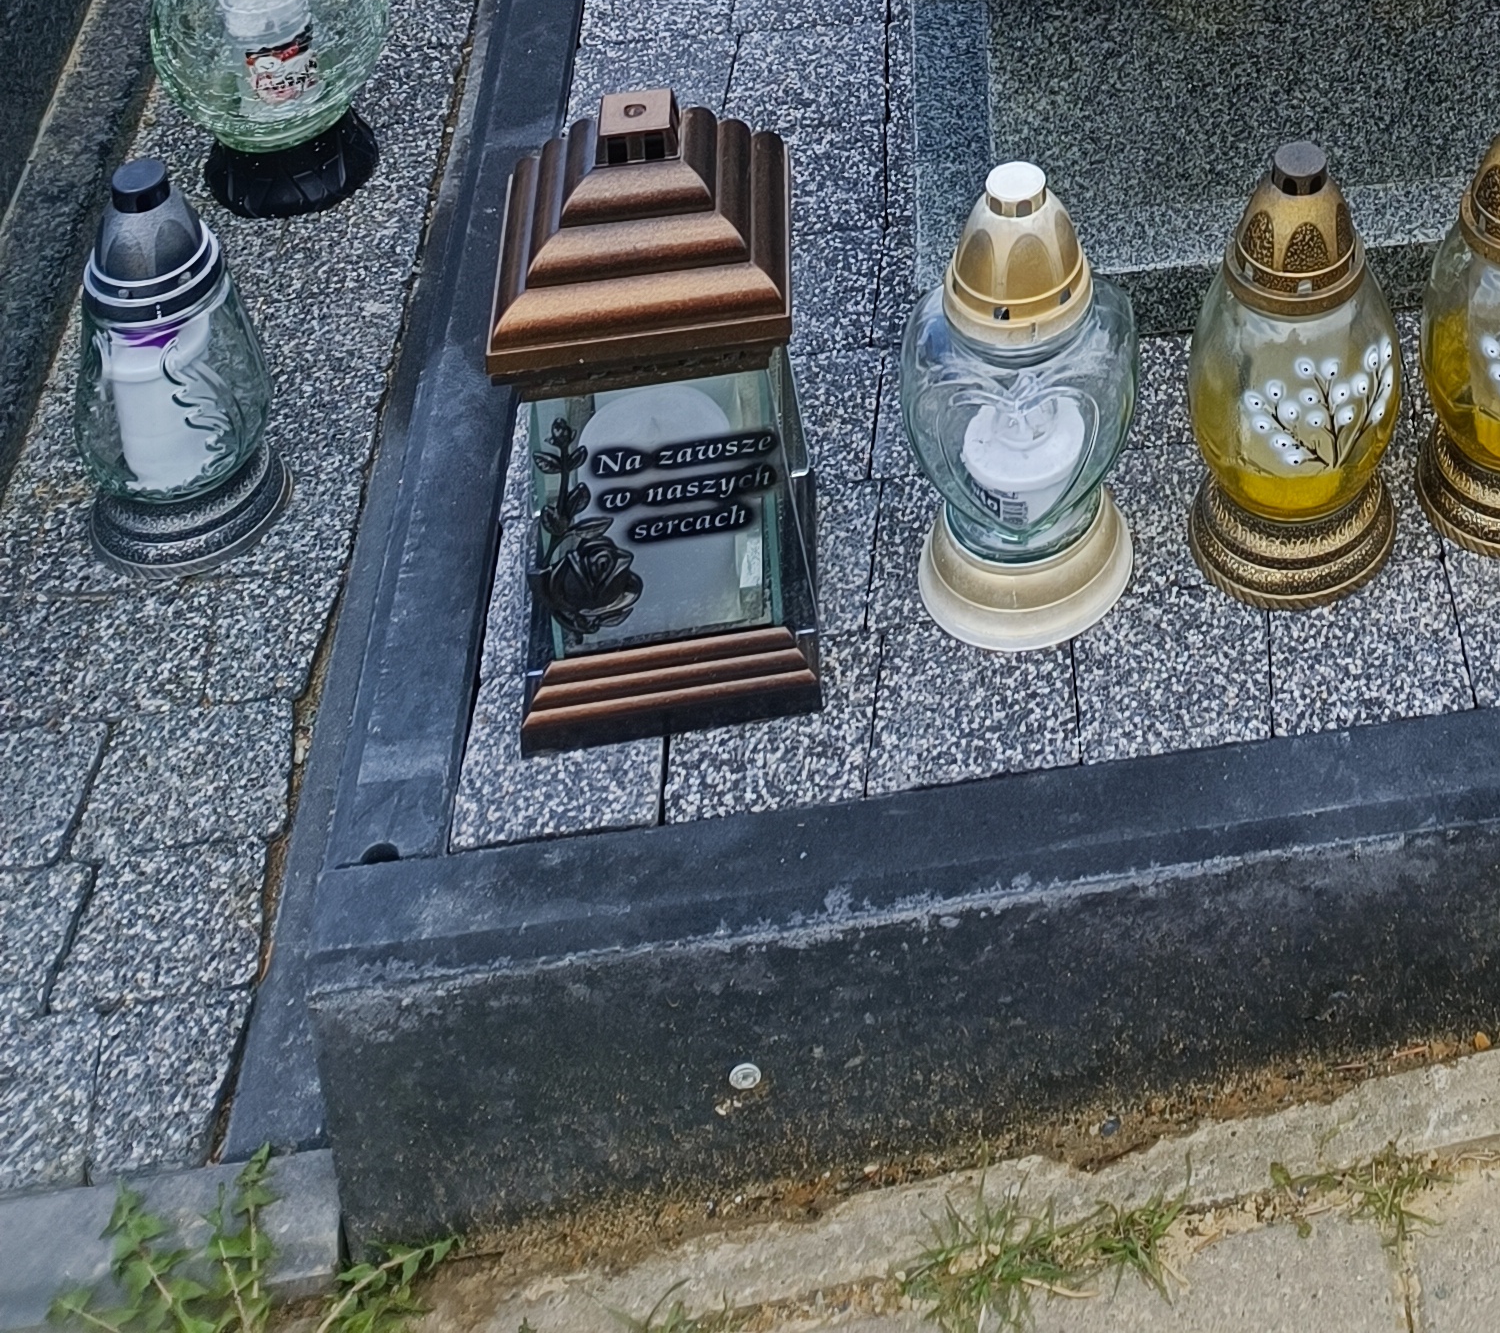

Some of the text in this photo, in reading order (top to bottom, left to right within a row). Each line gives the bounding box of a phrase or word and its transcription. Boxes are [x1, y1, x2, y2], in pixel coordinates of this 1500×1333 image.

[596, 434, 772, 475] Na zawsze
[603, 468, 771, 509] w naszych
[633, 504, 746, 539] sercach
